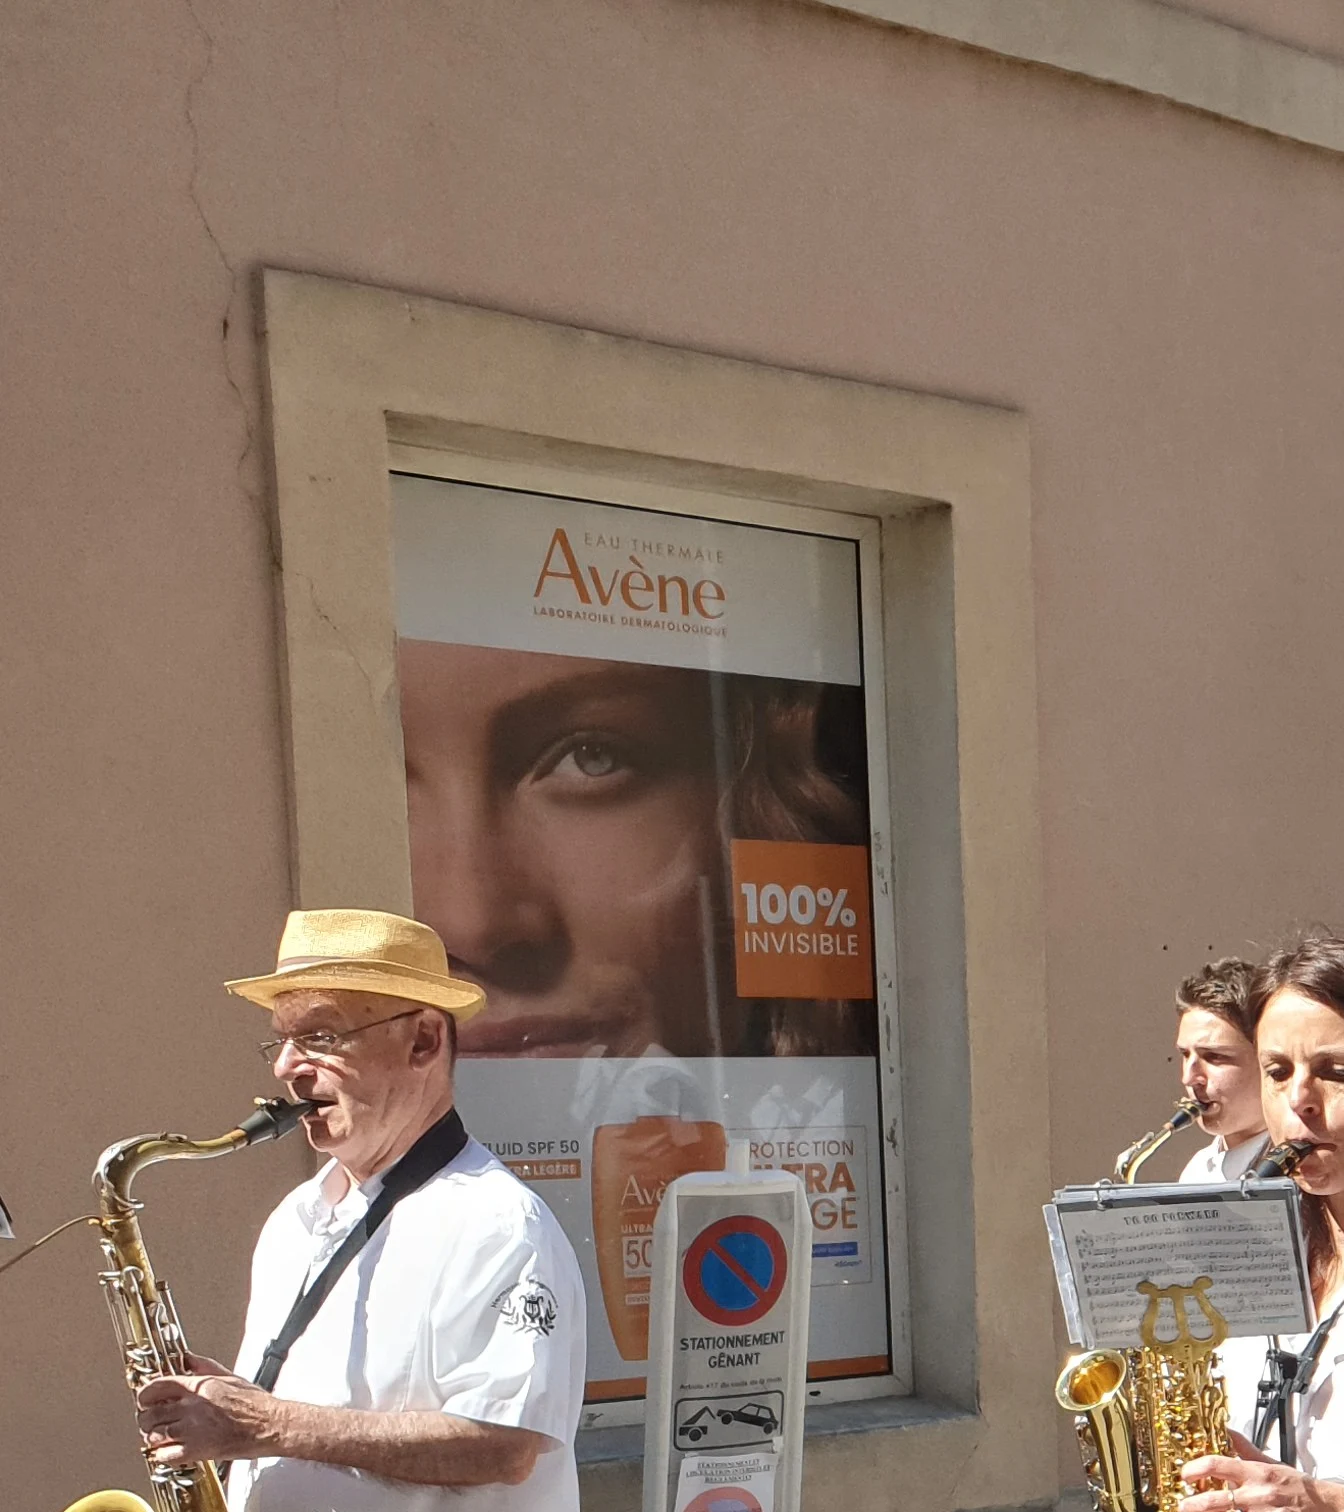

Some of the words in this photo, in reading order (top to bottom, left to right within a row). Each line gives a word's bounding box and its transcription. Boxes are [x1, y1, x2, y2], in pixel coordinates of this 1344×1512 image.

[584, 532, 620, 549] EAU
[533, 528, 725, 619] Avène
[533, 606, 615, 625] LABORATOIRE
[741, 883, 856, 927] 100%
[744, 931, 858, 955] INVISIBLE
[528, 1141, 555, 1154] SPF
[560, 1140, 579, 1153] 50
[750, 1140, 854, 1158] ROTECTION
[680, 1331, 785, 1351] STATIONNEMENT
[708, 1352, 761, 1369] GÊNANT
